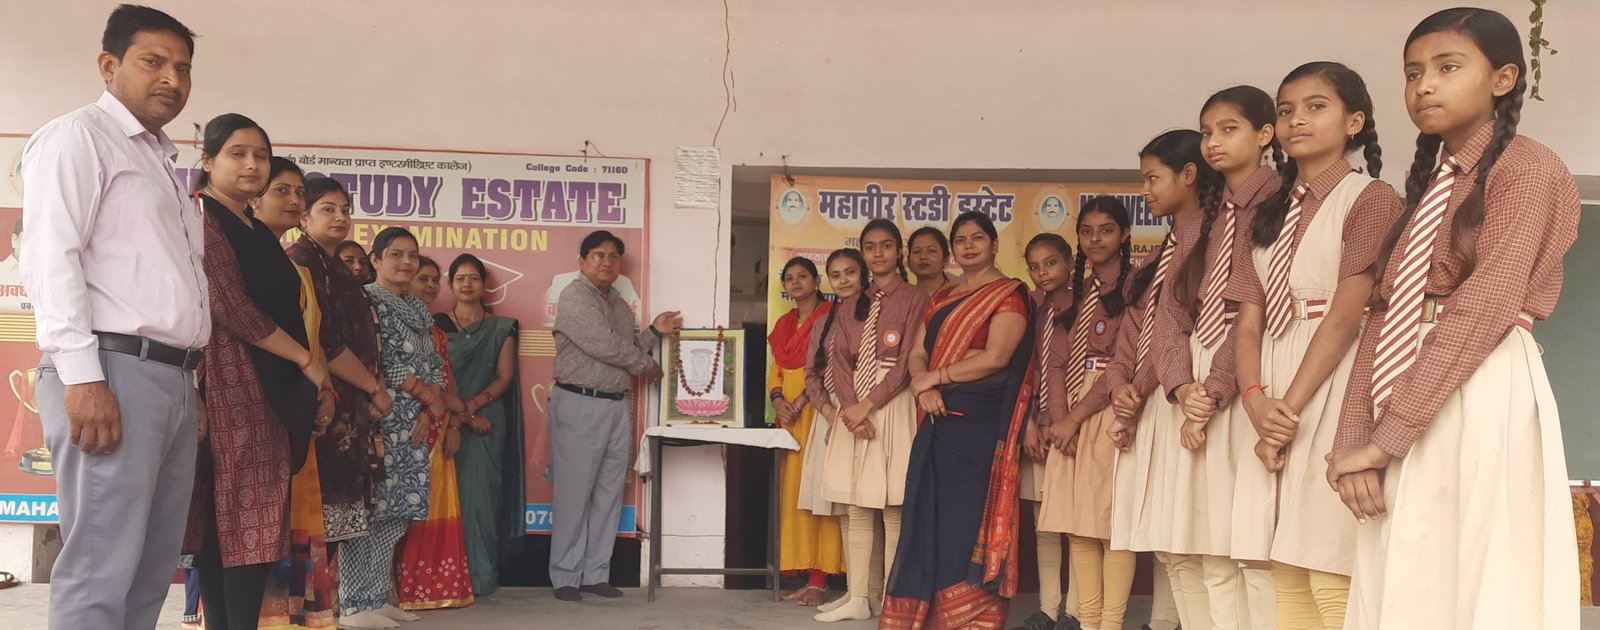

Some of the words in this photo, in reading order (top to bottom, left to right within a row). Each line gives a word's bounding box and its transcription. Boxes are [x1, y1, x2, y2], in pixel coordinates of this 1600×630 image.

[526, 163, 560, 173] College
[566, 164, 588, 172] Code
[602, 165, 628, 174] 71160
[304, 171, 442, 217] TUDY
[461, 177, 625, 223] ESTATE
[819, 184, 897, 220] महावीर
